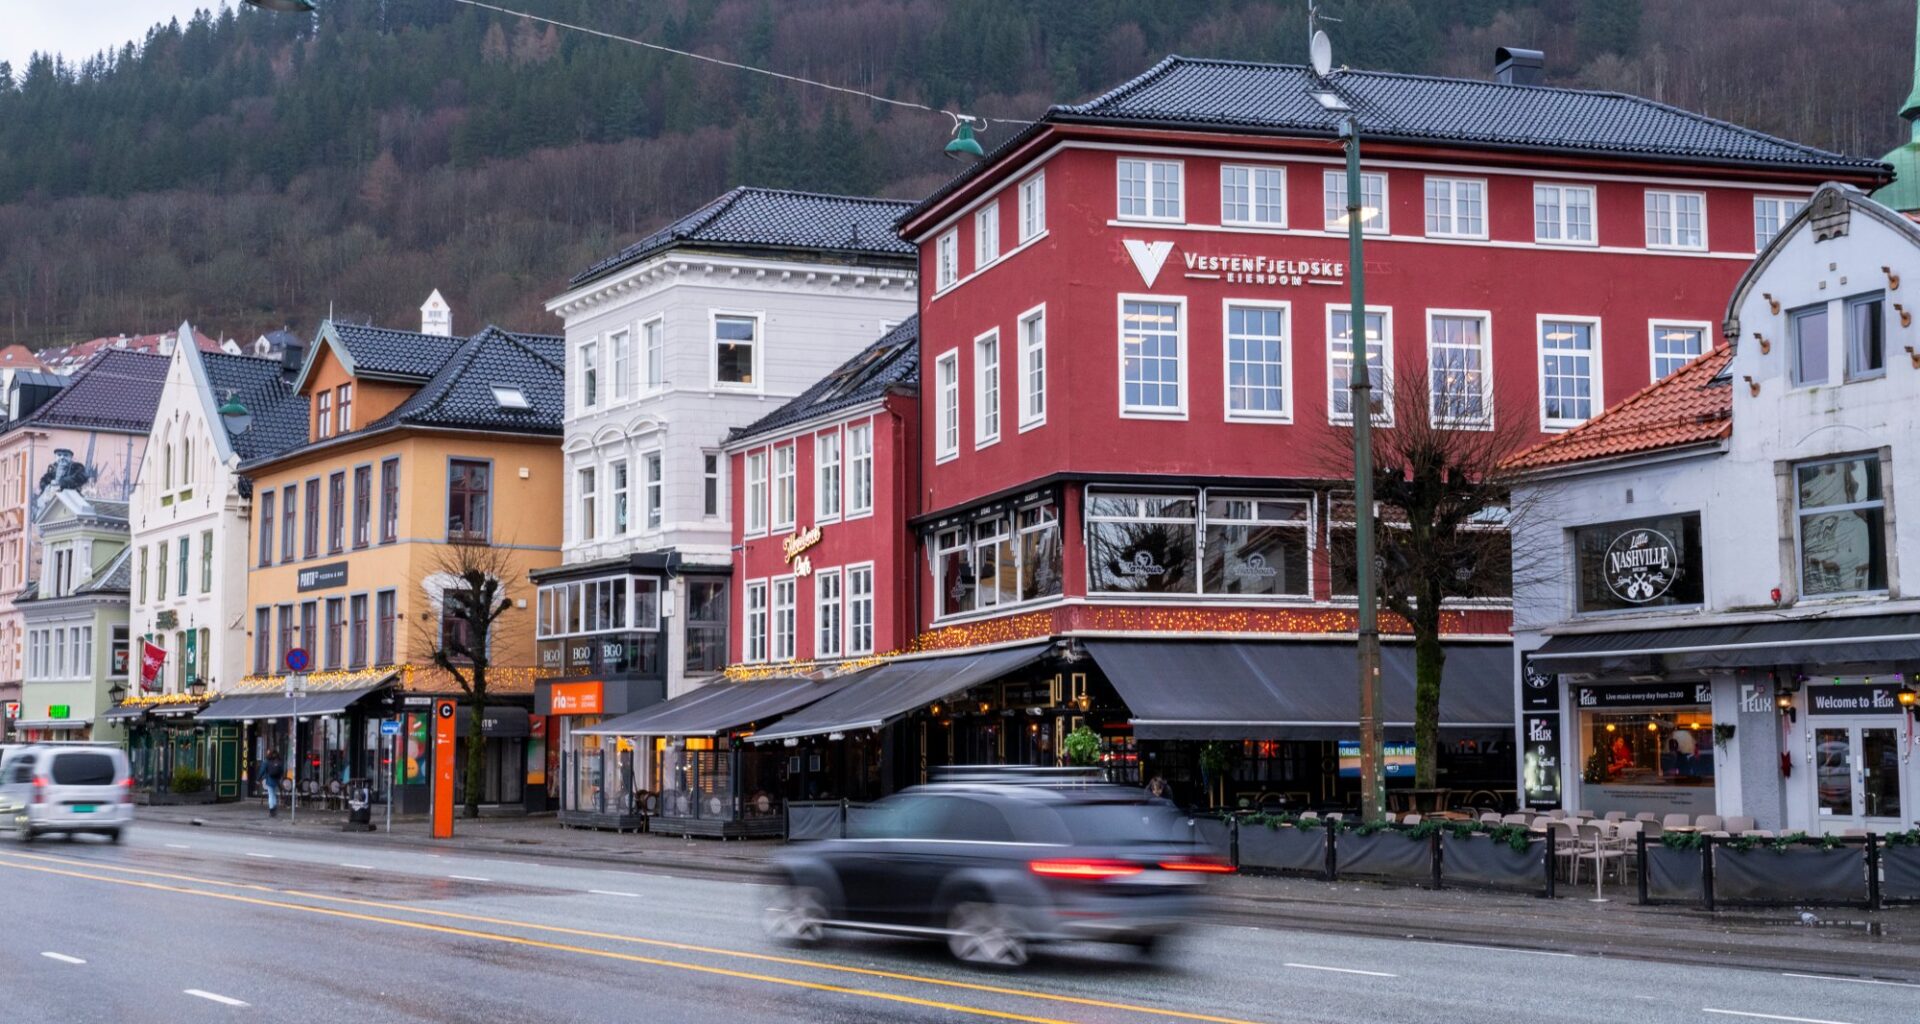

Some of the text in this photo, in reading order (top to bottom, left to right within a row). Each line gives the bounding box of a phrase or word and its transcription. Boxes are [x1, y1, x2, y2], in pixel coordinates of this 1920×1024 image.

[1183, 251, 1344, 277] VESTENFJELDSKE
[1227, 272, 1302, 286] EIENDOM
[1611, 546, 1669, 574] NASHVILLE
[543, 649, 561, 662] BGO
[572, 646, 591, 660] BGO
[603, 643, 622, 657] BGO
[1580, 688, 1597, 705] FELIX
[1646, 692, 1656, 700] day
[1738, 684, 1772, 713] FELIX
[1815, 689, 1894, 709] Welcome to FELIX
[442, 705, 451, 717] C
[1528, 718, 1552, 741] FELIX
